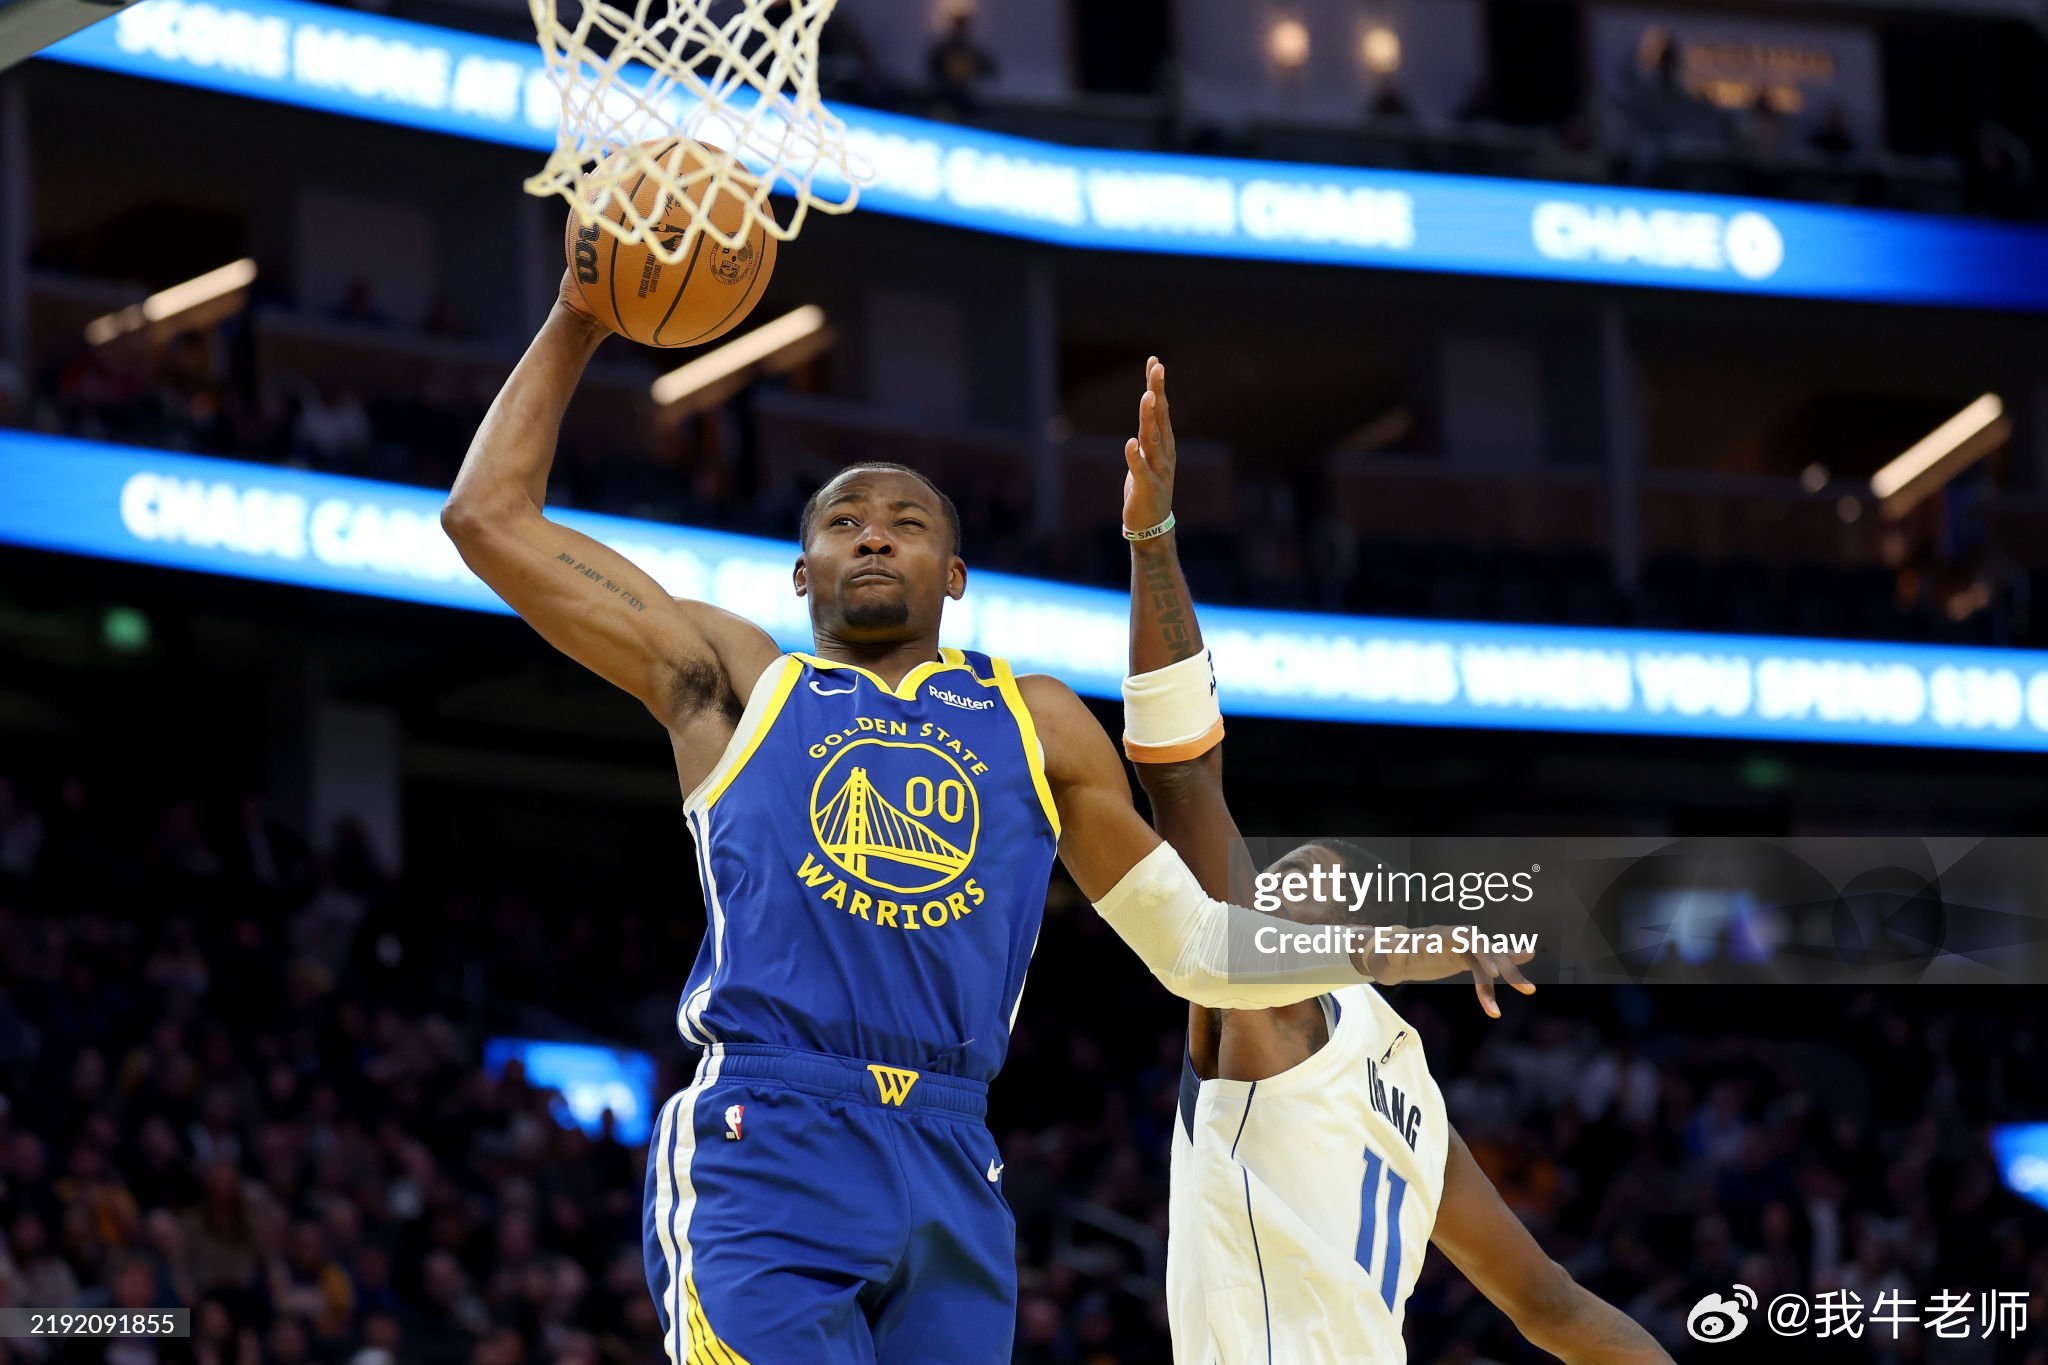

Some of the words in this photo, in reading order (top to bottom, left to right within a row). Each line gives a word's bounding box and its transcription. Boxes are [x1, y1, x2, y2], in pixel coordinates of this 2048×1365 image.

[1240, 180, 1415, 249] CHASE
[1532, 203, 1725, 270] CHASE
[1138, 526, 1163, 539] SAVE
[121, 473, 305, 559] CHASE
[1636, 652, 1752, 717] YOU
[1756, 657, 1926, 725] SPEND
[556, 552, 575, 565] NO
[602, 580, 620, 593] NO
[928, 684, 995, 711] Rakuten
[808, 717, 907, 760] GOLDEN
[919, 722, 989, 776] STATE
[905, 776, 966, 823] 00
[796, 852, 986, 930] WARRIORS
[1354, 1144, 1408, 1315] 11
